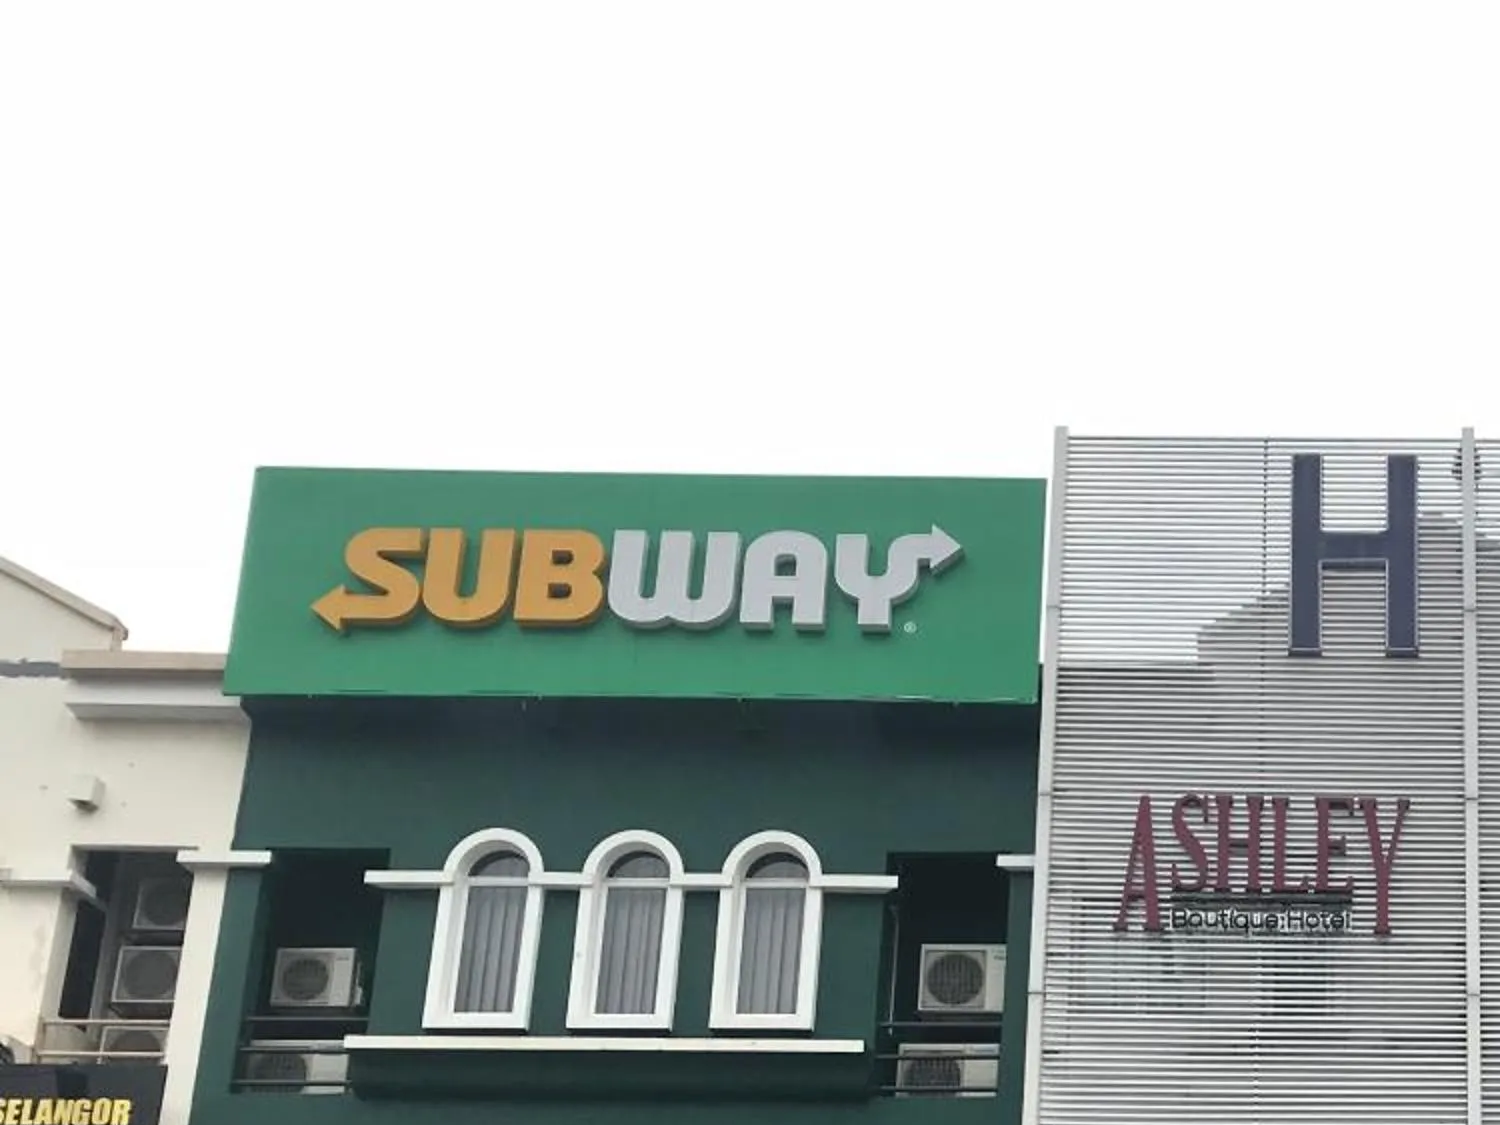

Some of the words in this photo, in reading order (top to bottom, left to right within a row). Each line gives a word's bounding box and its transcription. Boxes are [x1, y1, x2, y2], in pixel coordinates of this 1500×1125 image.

[310, 524, 963, 634] SUBWAY
[1112, 793, 1411, 935] ASHLEY
[1170, 907, 1285, 935] Boutique
[1287, 907, 1352, 930] Hotel
